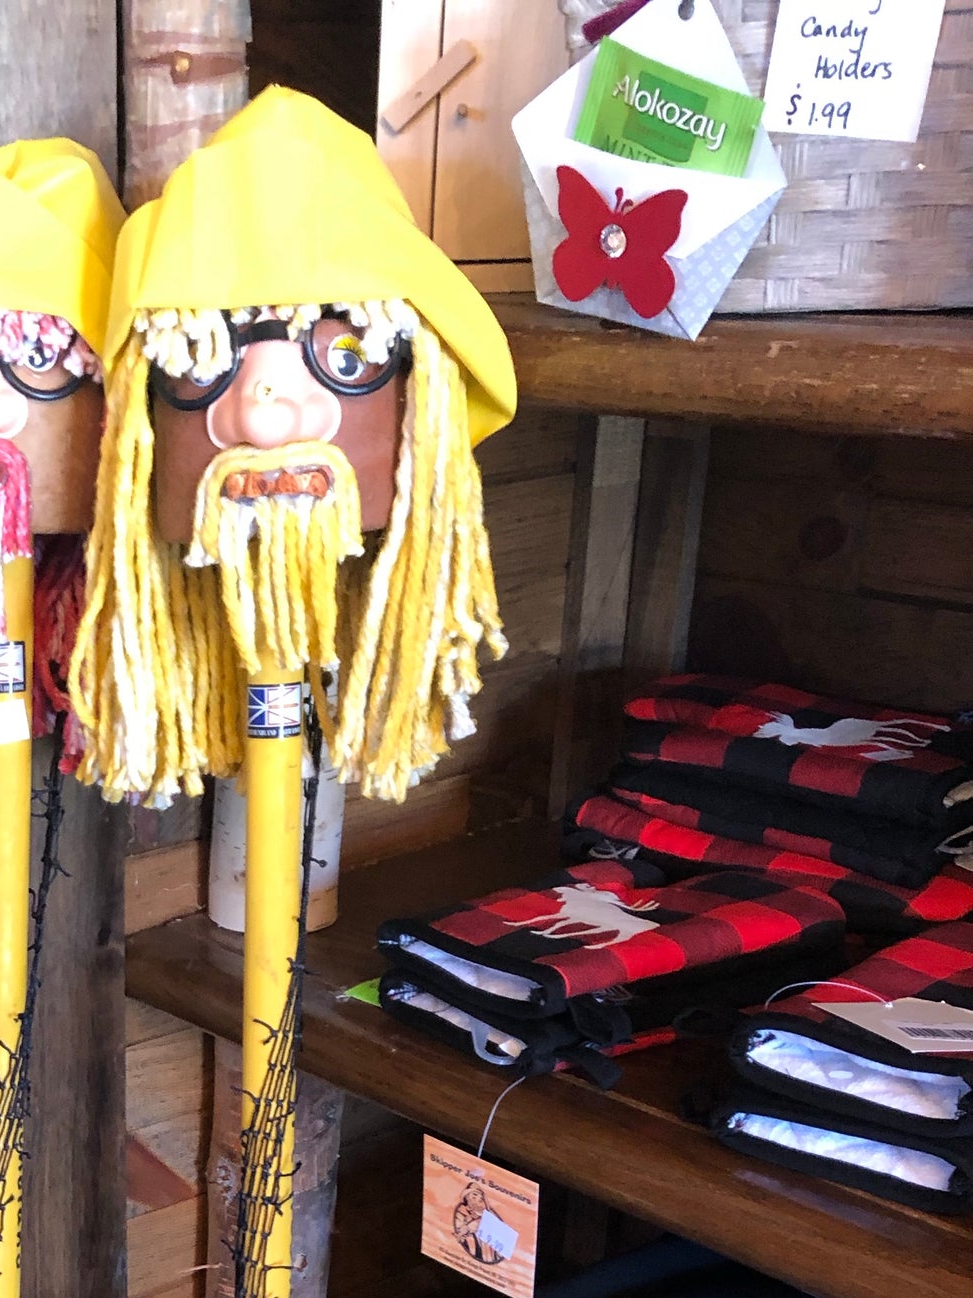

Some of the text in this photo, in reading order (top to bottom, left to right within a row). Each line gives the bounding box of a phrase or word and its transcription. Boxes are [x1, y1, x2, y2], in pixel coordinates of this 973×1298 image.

[801, 16, 868, 54] Candy
[814, 55, 892, 80] Holders
[612, 75, 726, 151] Alokozay
[430, 1153, 463, 1174] Skipper
[488, 1180, 532, 1206] Souvenirs
